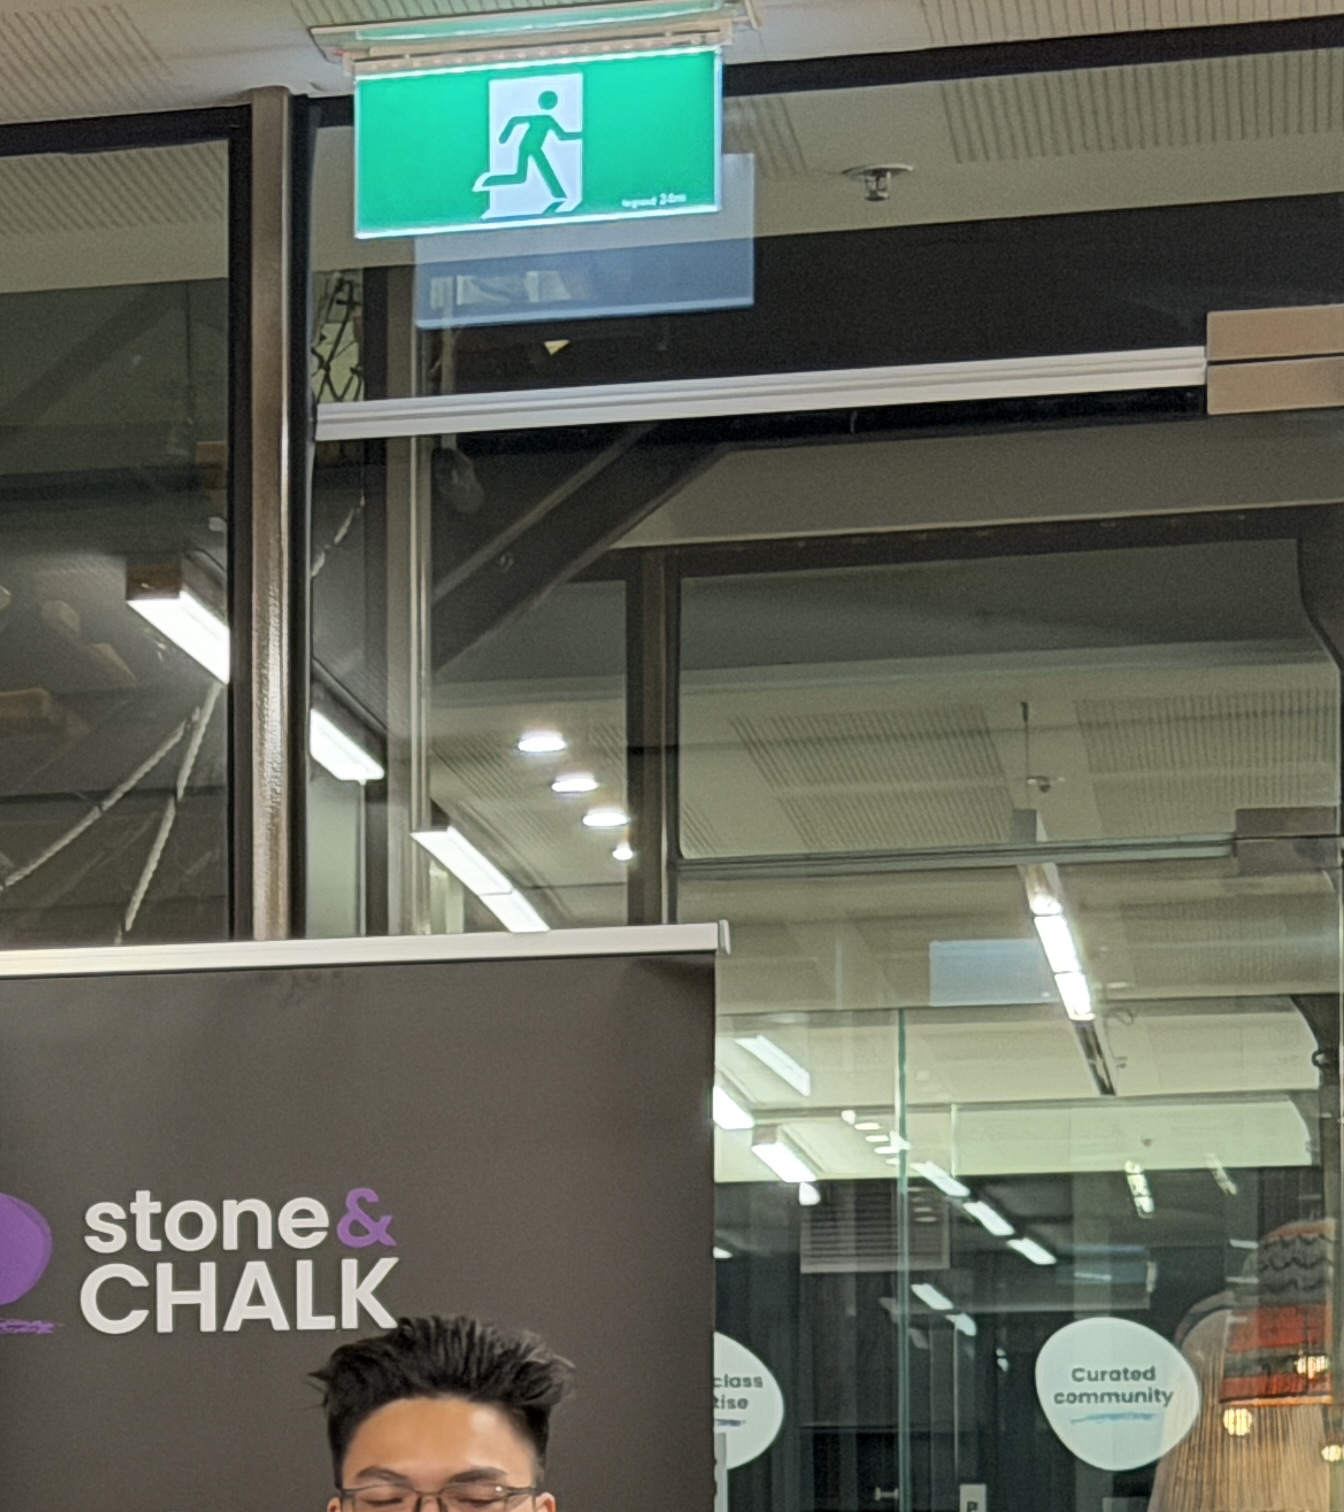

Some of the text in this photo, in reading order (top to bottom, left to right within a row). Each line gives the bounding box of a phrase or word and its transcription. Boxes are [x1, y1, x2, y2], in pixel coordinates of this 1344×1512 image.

[83, 1187, 398, 1254] stone&
[79, 1256, 400, 1335] CHALK
[1070, 1365, 1157, 1383] Curated
[1053, 1386, 1174, 1408] community
